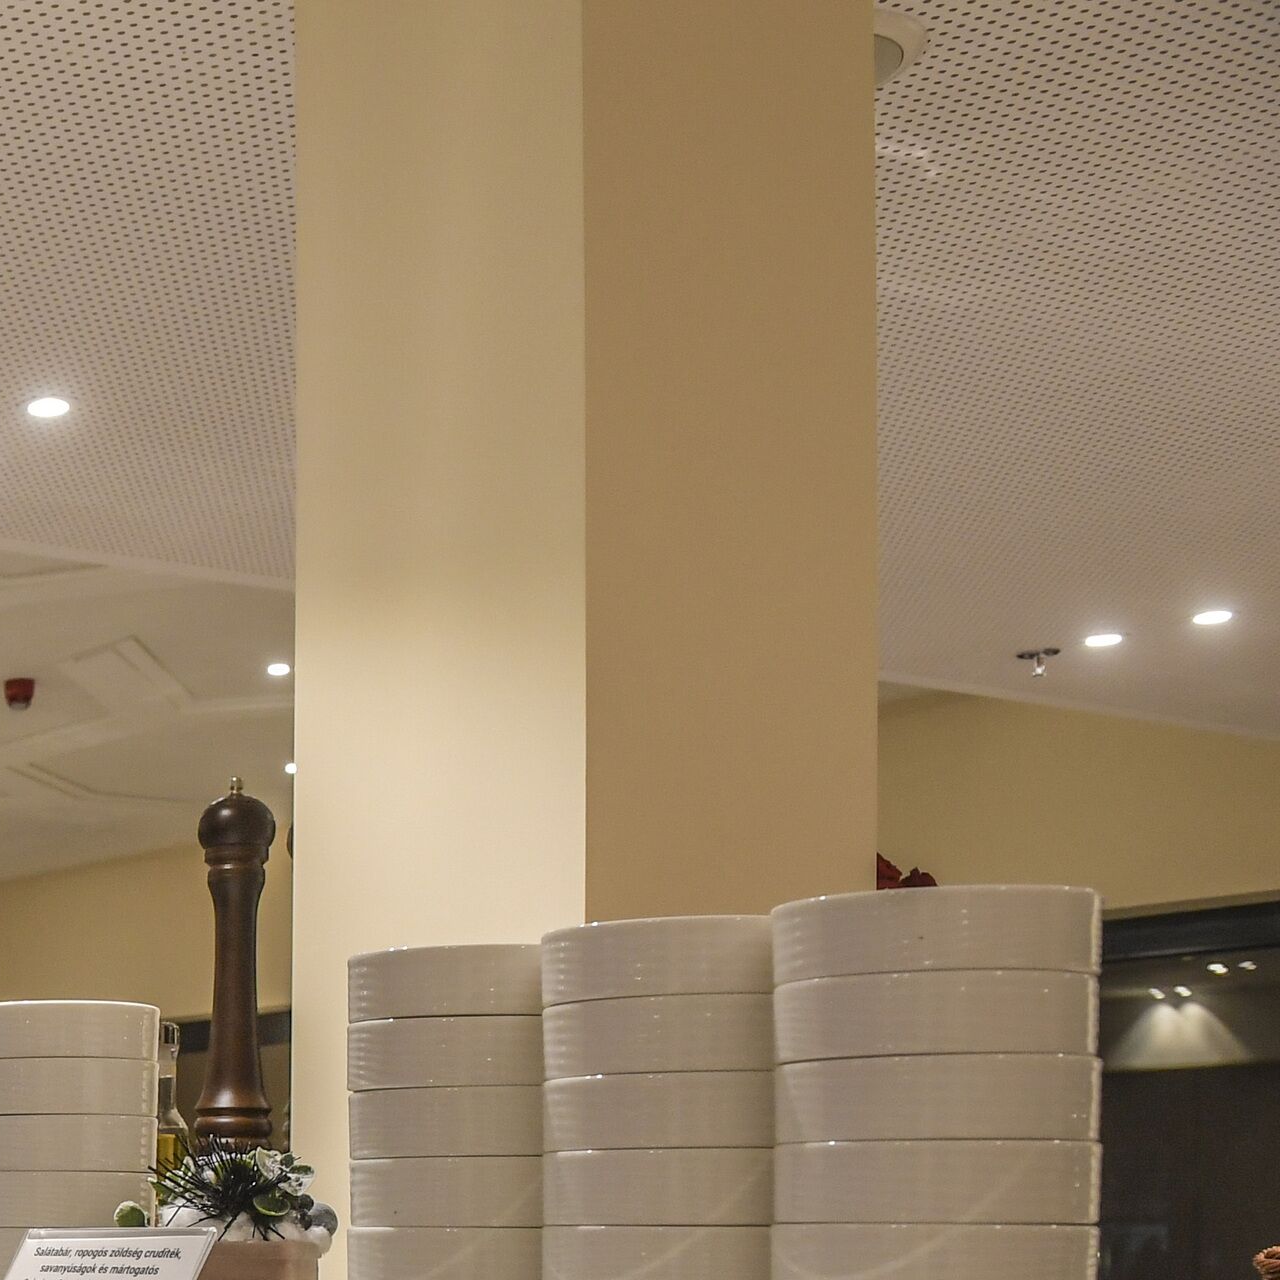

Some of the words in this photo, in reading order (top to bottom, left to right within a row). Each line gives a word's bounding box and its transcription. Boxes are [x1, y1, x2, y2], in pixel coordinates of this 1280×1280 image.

[109, 1247, 143, 1260] zöldség
[98, 1263, 108, 1274] és
[109, 1264, 160, 1277] mártogatós
